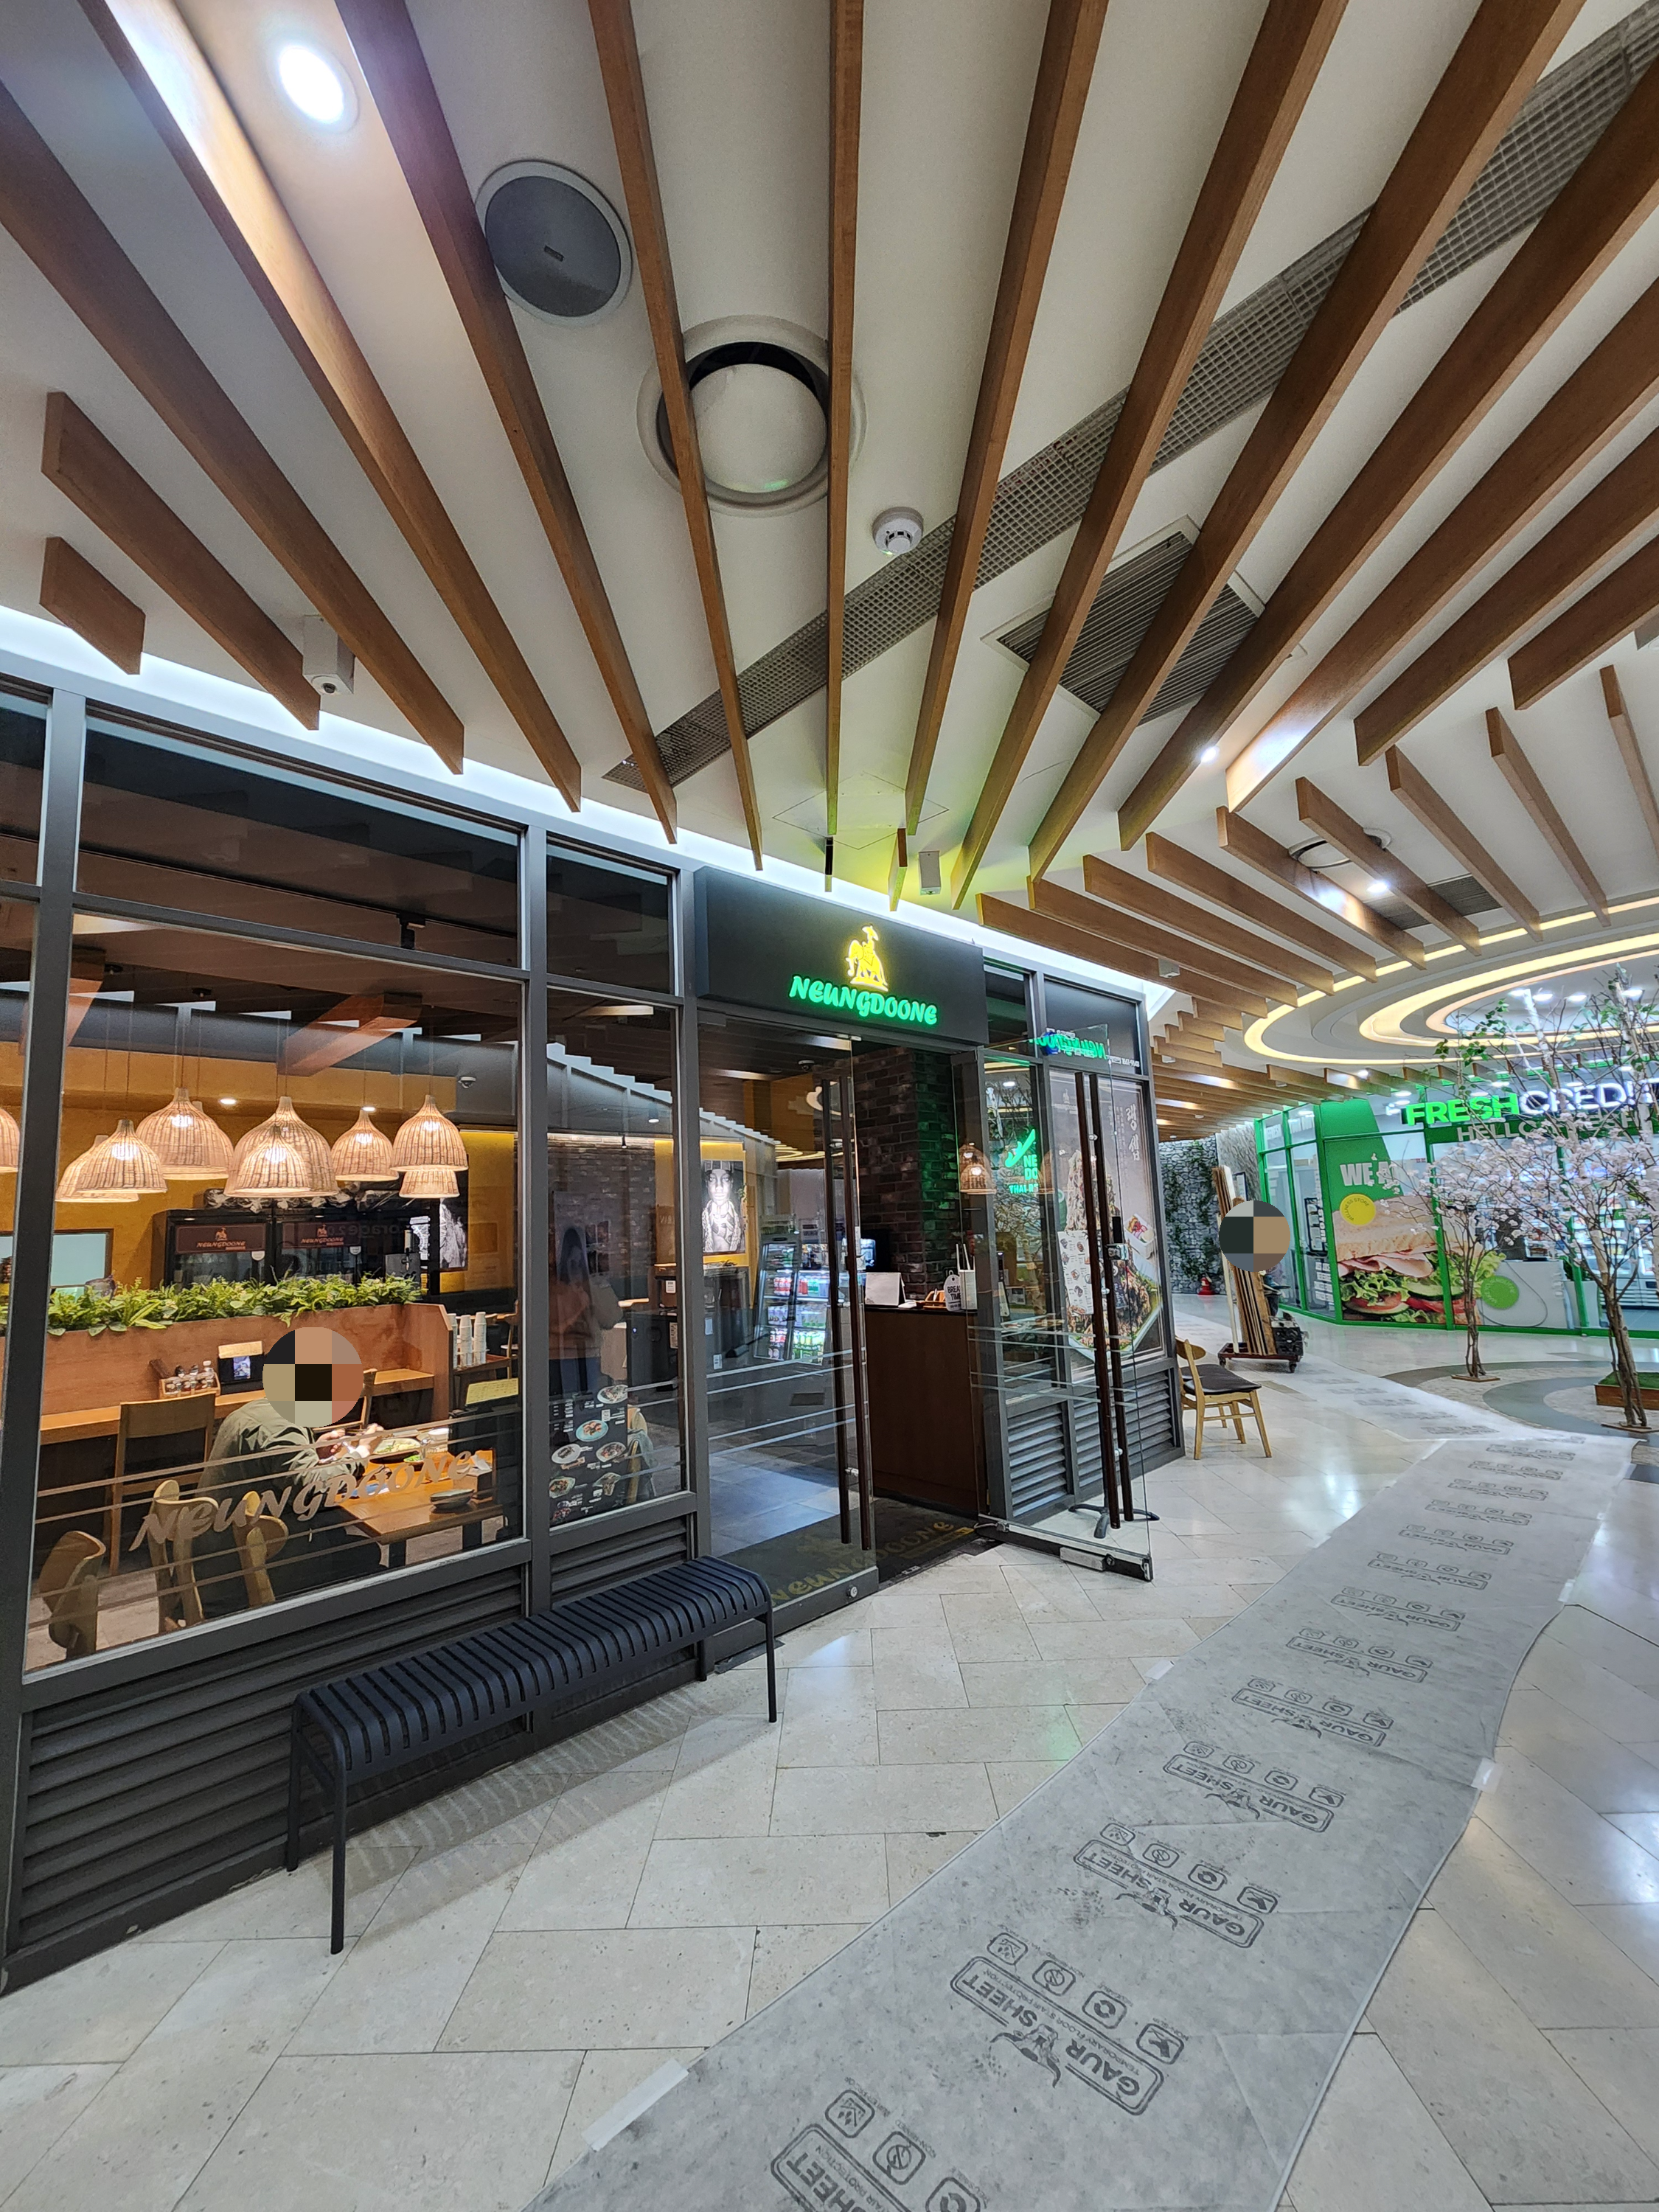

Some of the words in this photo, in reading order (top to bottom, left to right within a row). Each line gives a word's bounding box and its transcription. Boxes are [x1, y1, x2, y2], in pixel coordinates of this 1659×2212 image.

[789, 975, 937, 1024] NEUNGDOONE
[1406, 1093, 1520, 1126] FRESH
[1340, 1163, 1374, 1186] WE
[1354, 1197, 1370, 1207] STORE
[129, 1451, 471, 1551] NEUNGDOONE
[1293, 1642, 1345, 1658] SHEET
[1367, 1660, 1416, 1677] GAUR
[1237, 1696, 1296, 1717] SHEET
[1319, 1720, 1373, 1741] GAUR
[1172, 1764, 1234, 1790] SHEET
[1259, 1795, 1318, 1823] GAUR
[1083, 1852, 1152, 1889] SHEET
[1179, 1898, 1245, 1935] GAUR
[962, 1975, 1037, 2027] SHEET
[1032, 2000, 1056, 2020] STAIR
[1055, 2017, 1085, 2039] FLOOR
[1065, 2039, 1140, 2096] GAUR
[1085, 2036, 1141, 2075] TEMPORARY
